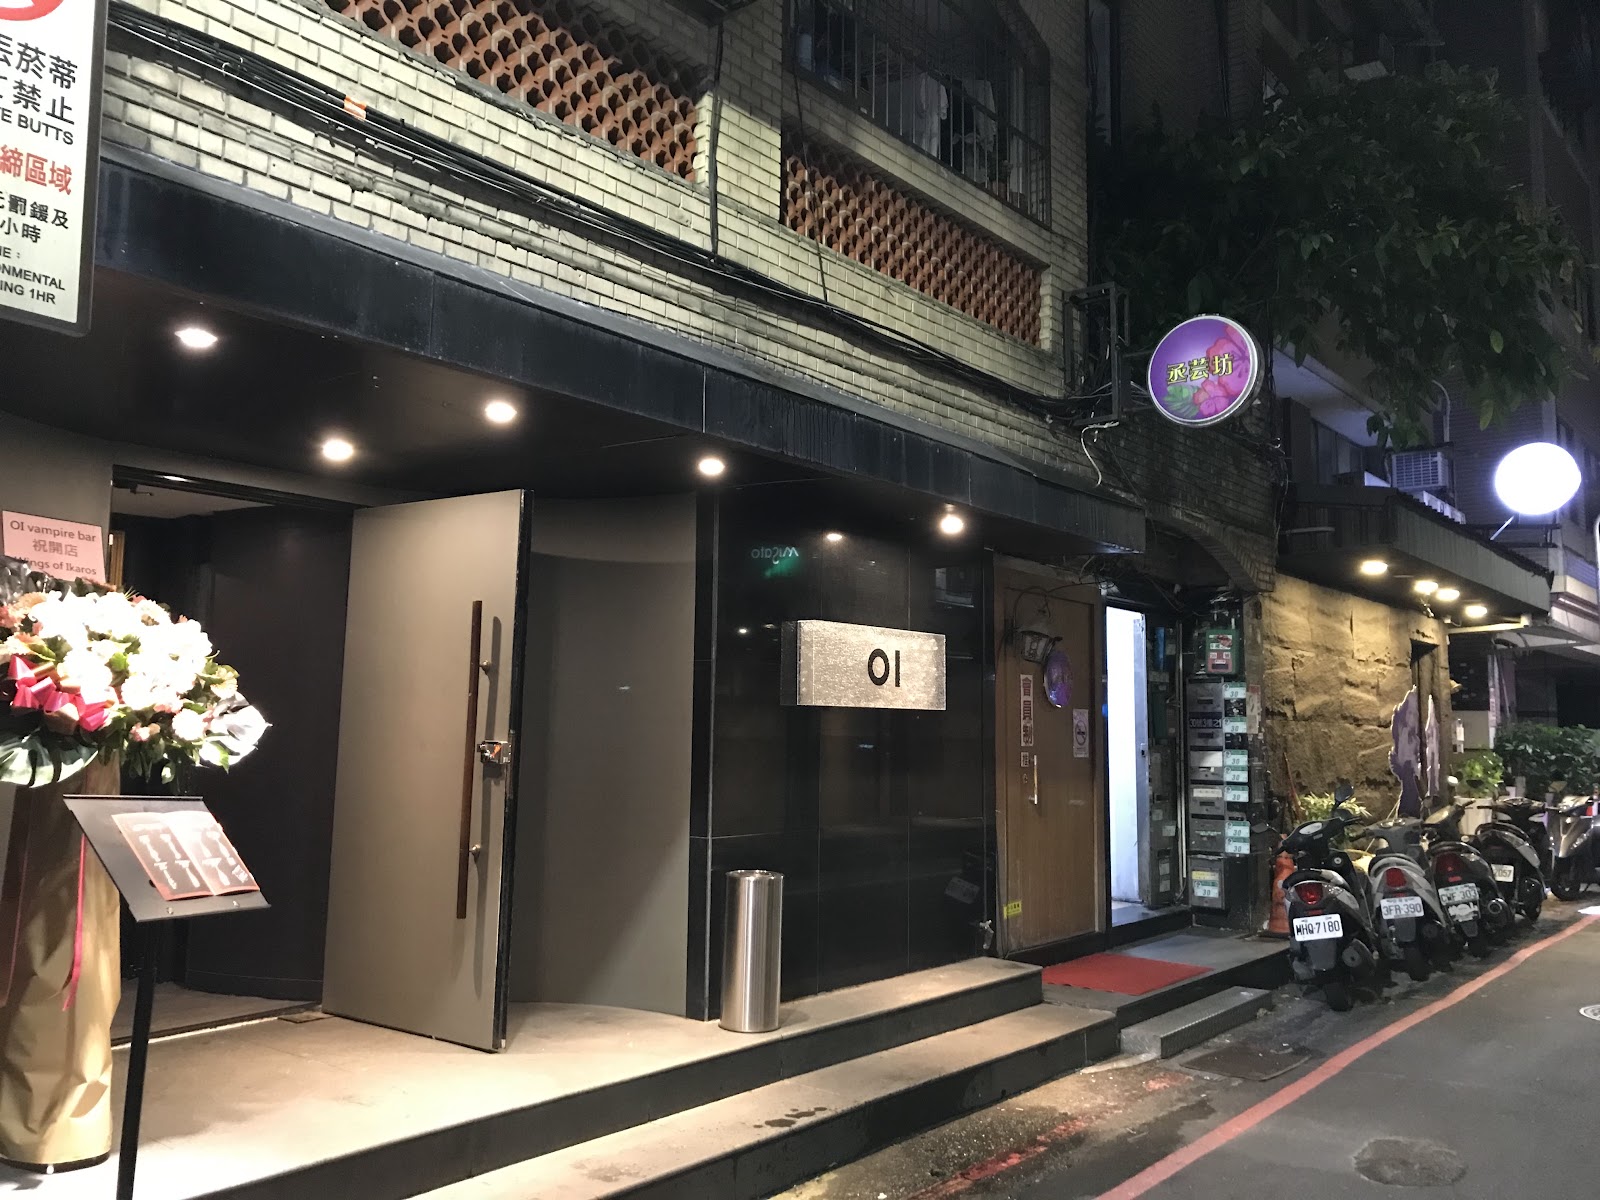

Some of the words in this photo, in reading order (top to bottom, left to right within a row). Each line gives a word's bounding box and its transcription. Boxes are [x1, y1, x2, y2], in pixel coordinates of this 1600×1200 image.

[0, 75, 75, 126] 禁止
[17, 113, 74, 146] BUTTS
[0, 191, 69, 230] 罰鍰及
[0, 216, 42, 244] 小時
[0, 262, 66, 291] NMENTAL
[29, 288, 56, 305] 1HR
[1166, 352, 1235, 385] 丞芸坊
[27, 524, 75, 539] vampire
[78, 530, 97, 542] bar
[32, 538, 79, 558] 祝開店
[14, 556, 50, 570] ngs
[53, 561, 63, 570] of
[66, 562, 97, 575] Ikaros
